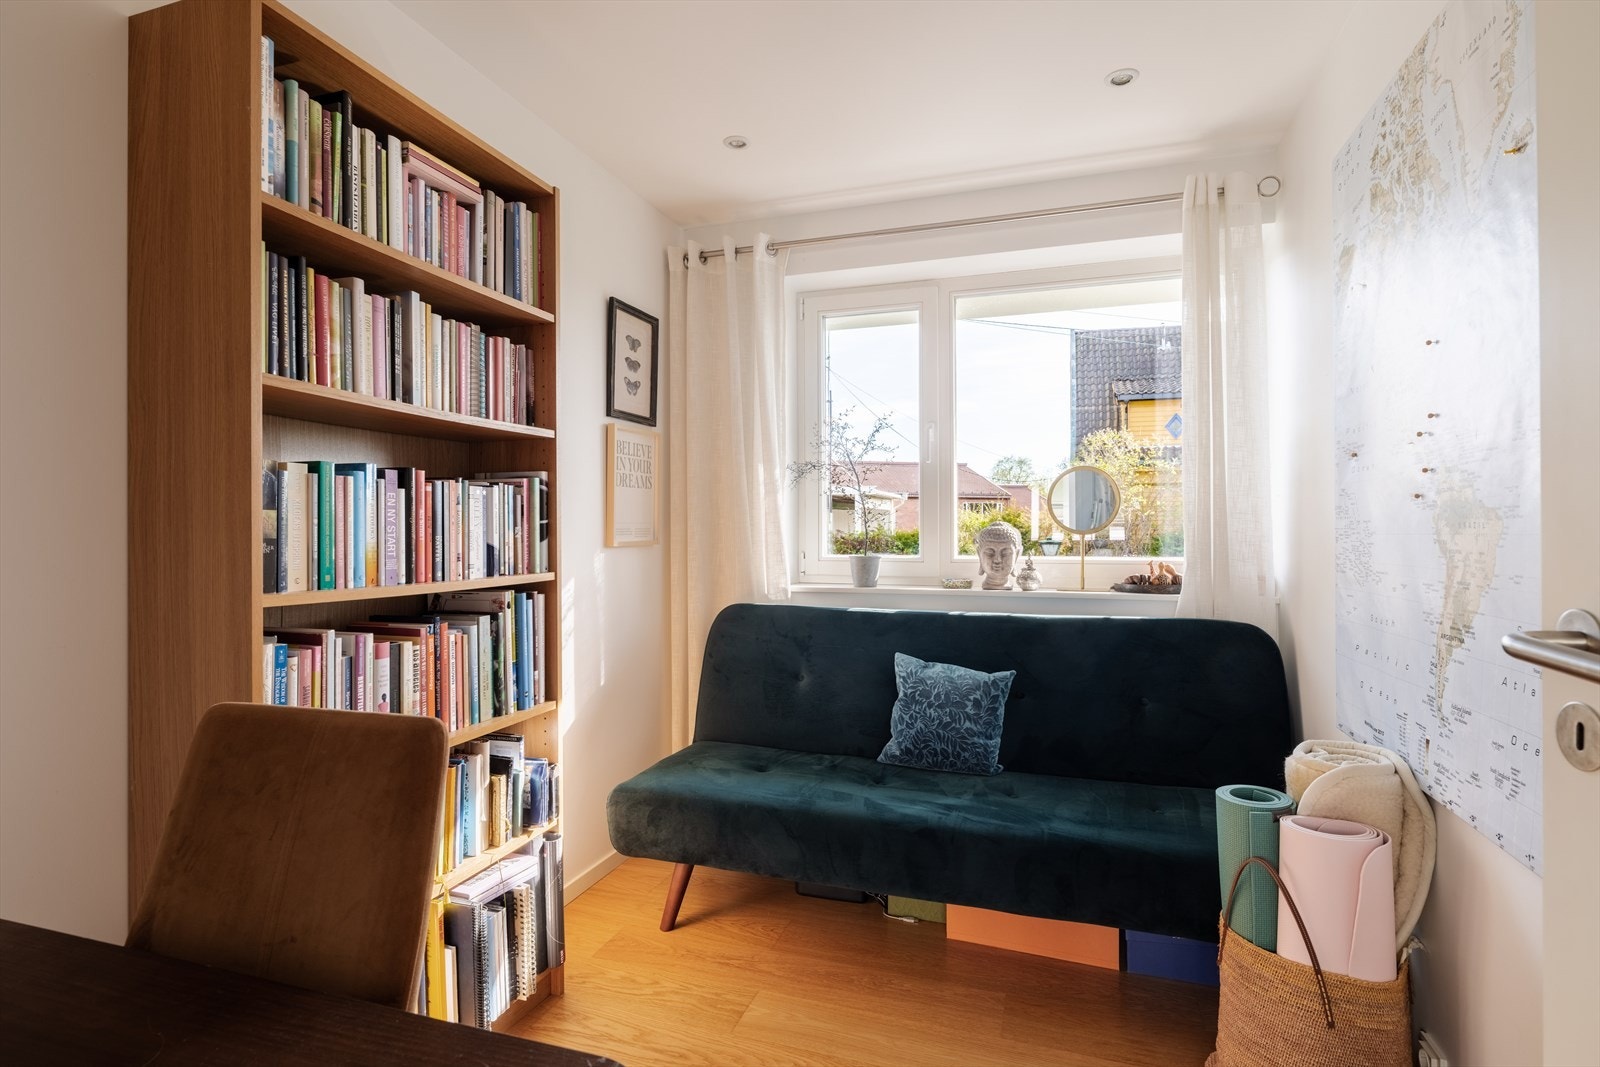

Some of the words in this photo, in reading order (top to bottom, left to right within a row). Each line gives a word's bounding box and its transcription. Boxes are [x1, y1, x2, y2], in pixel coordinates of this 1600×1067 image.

[616, 440, 652, 460] BELIEVE
[616, 456, 626, 471] IN
[628, 458, 652, 475] YOUR
[616, 474, 653, 490] DREAMS
[387, 492, 396, 506] EN
[387, 508, 396, 523] NY
[387, 525, 396, 558] START
[1440, 633, 1466, 645] ARGENTINA
